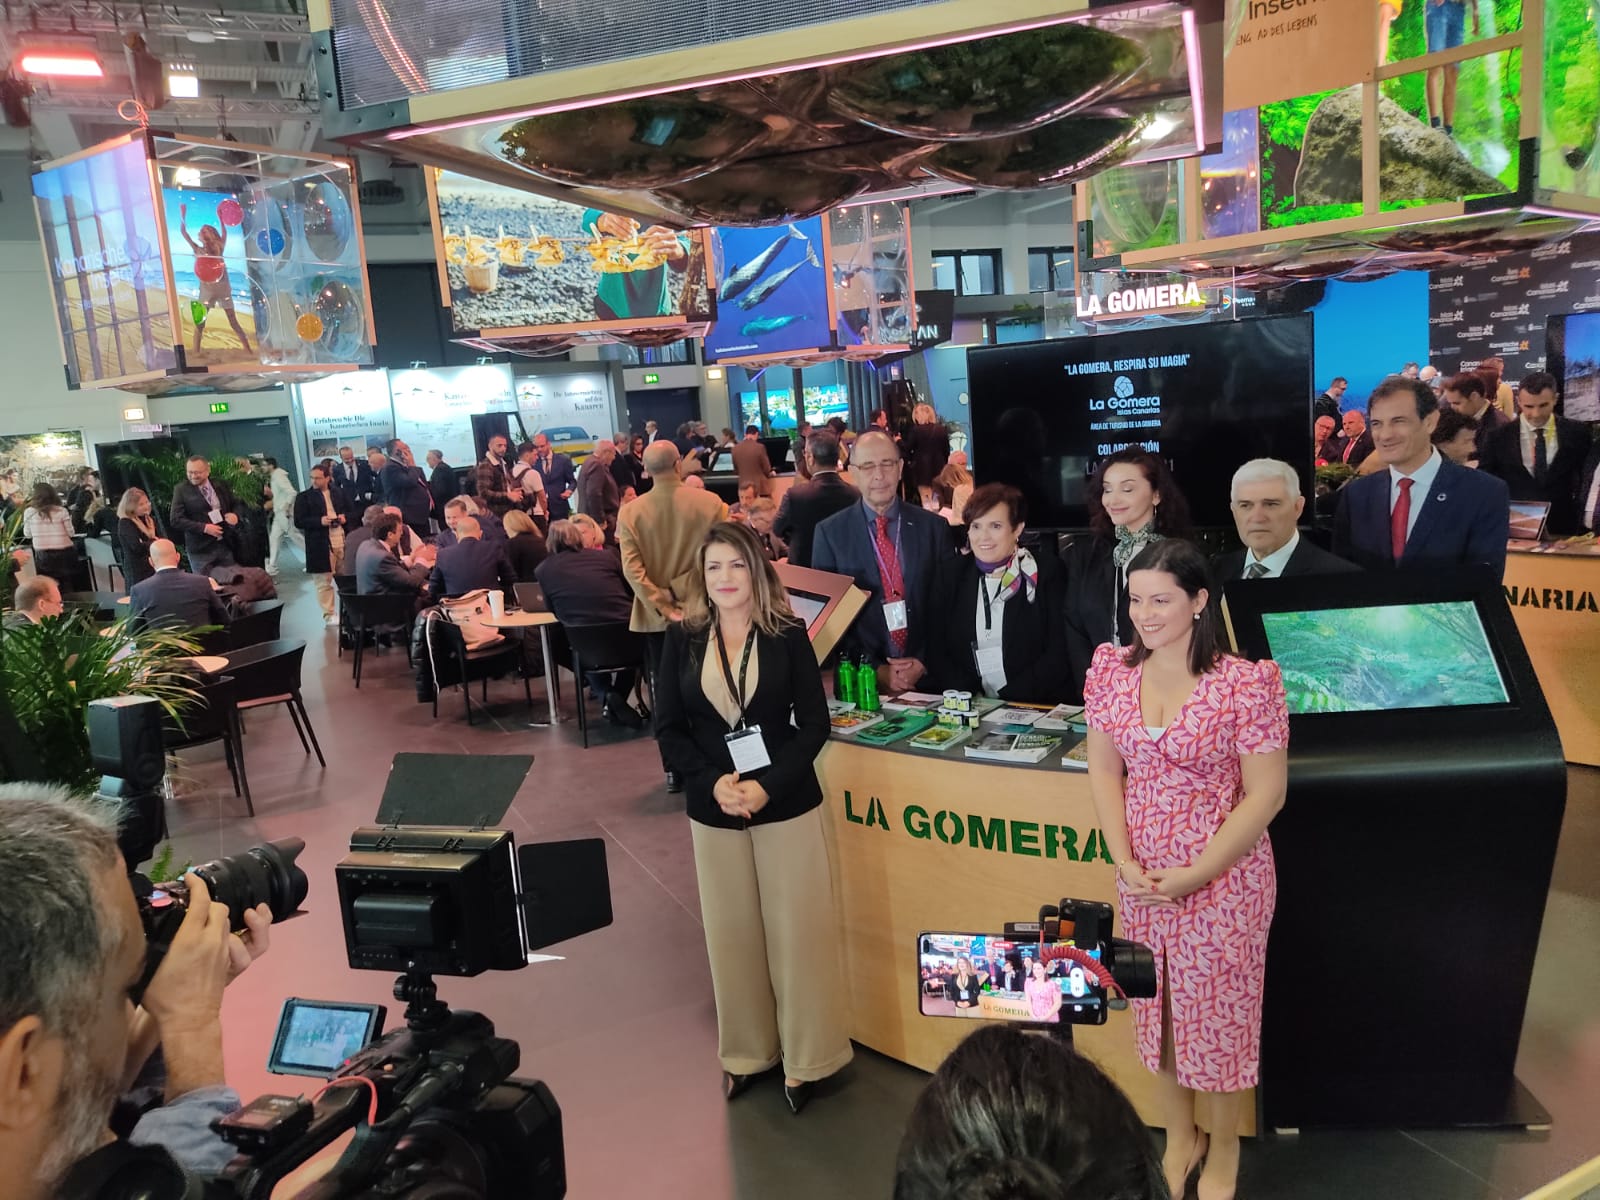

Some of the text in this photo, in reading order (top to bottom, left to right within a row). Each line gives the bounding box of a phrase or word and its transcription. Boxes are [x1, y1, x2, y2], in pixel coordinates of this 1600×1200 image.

[1249, 0, 1316, 19] Inse
[1271, 23, 1285, 37] DES
[1287, 14, 1318, 32] LEBENS
[1076, 281, 1201, 318] LA GOMERA
[1079, 361, 1113, 374] GOMERA,
[1114, 358, 1147, 371] RESPIRA
[1148, 356, 1158, 368] SU
[1160, 353, 1190, 367] MAGIA"
[1089, 396, 1160, 410] La Gomera
[1117, 407, 1160, 416] Islas Canarias
[1097, 440, 1159, 455] COLABCIÓN
[1502, 585, 1599, 613] NARIA
[844, 790, 1115, 865] LA GOMERA
